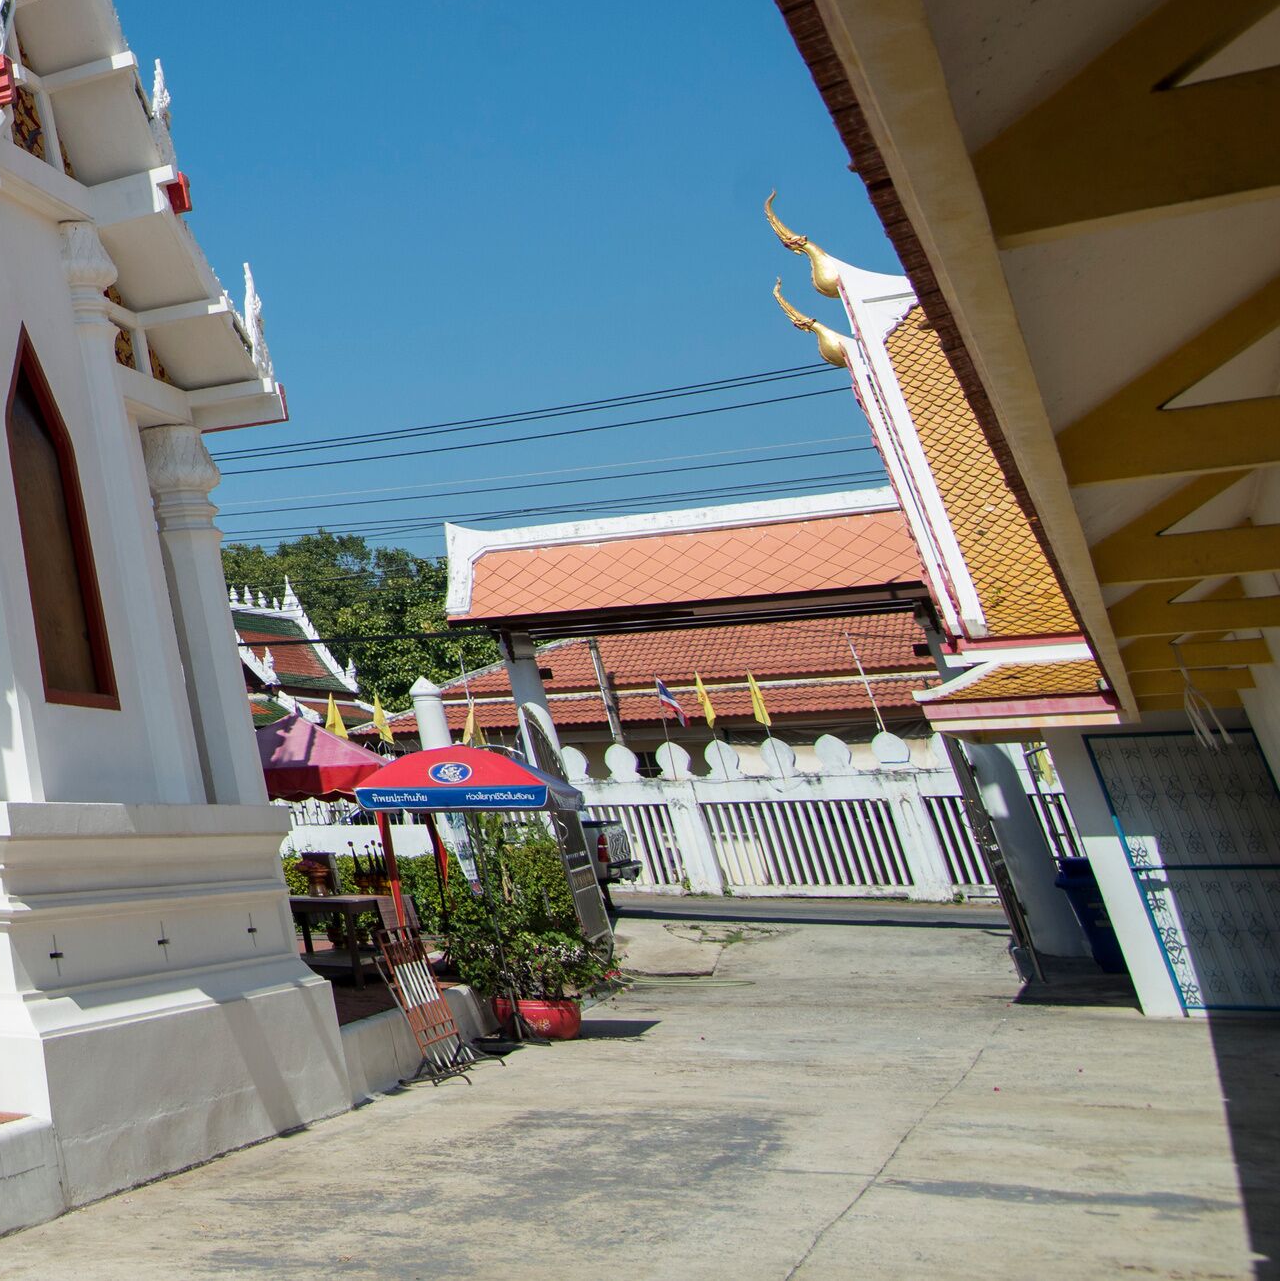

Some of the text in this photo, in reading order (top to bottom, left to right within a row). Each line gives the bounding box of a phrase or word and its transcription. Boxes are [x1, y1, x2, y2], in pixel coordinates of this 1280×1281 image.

[372, 793, 428, 803] ทิพยประกันภัย
